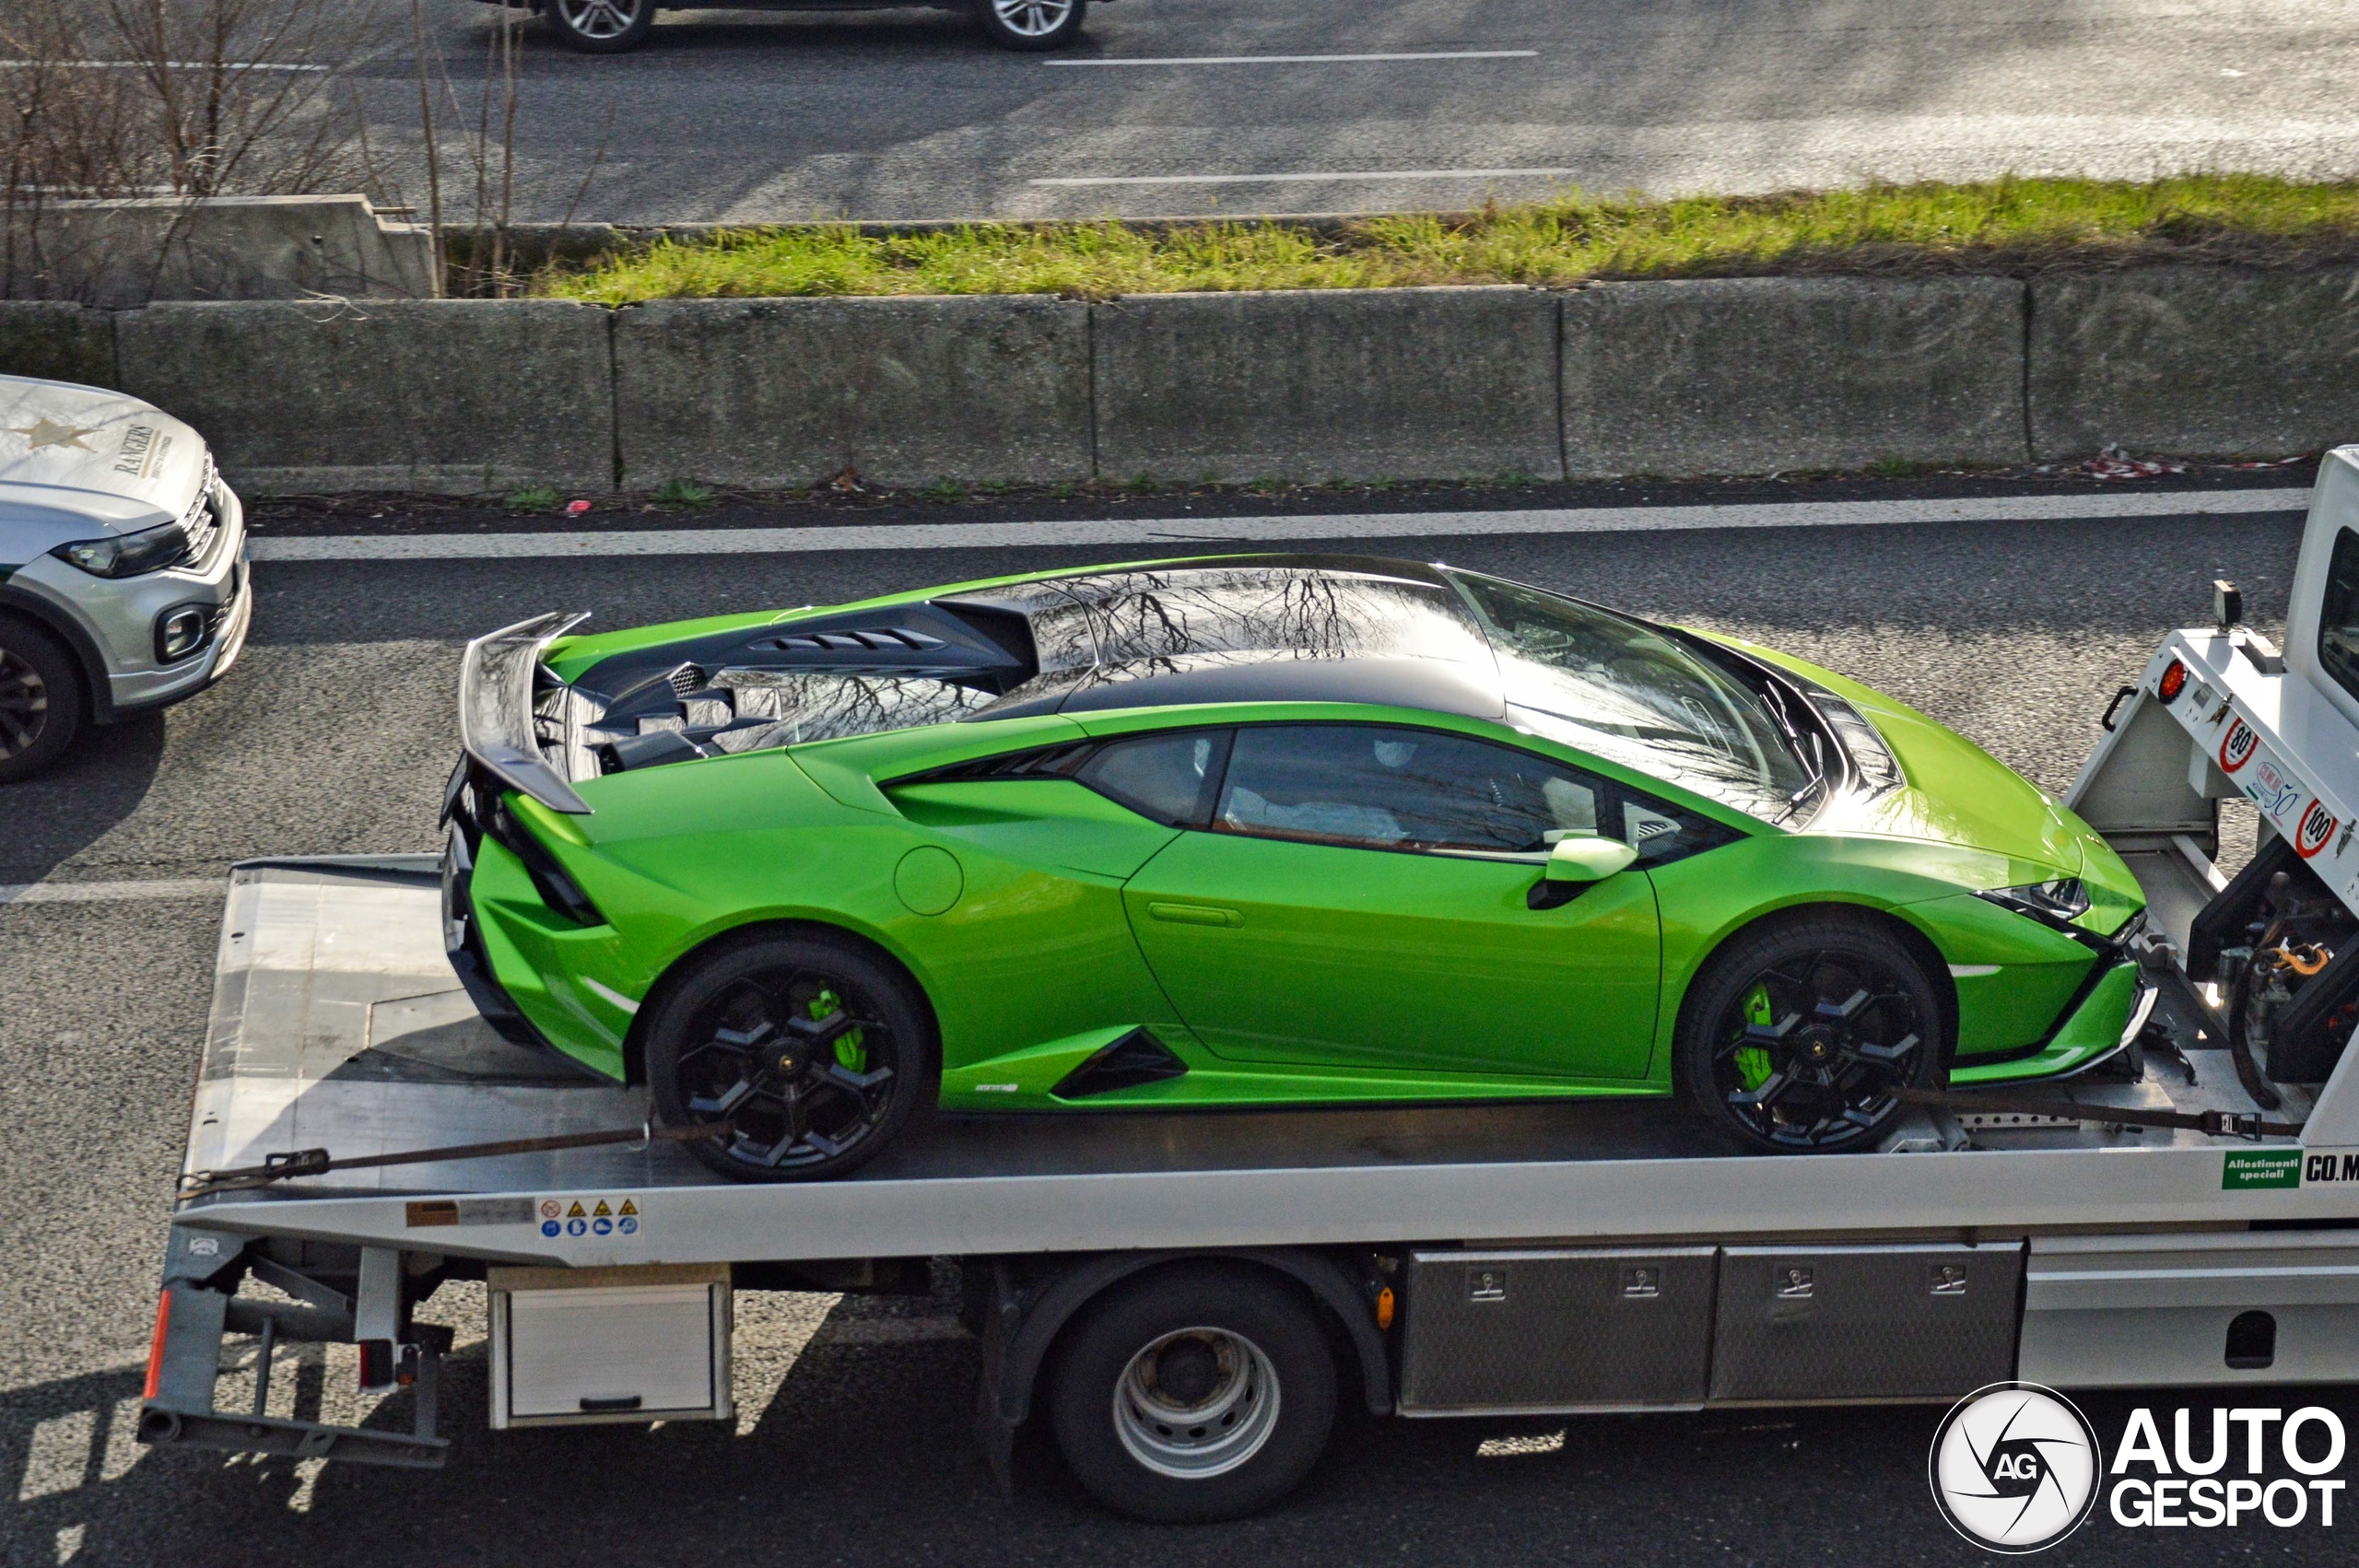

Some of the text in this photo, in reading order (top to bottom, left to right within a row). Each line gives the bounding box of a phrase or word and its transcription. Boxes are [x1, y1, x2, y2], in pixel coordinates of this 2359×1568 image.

[114, 423, 154, 476] RANGERS
[2231, 726, 2251, 755] 80
[2306, 807, 2330, 842] 100
[2227, 1158, 2298, 1169] Allestimenti
[2239, 1169, 2284, 1181] speciali
